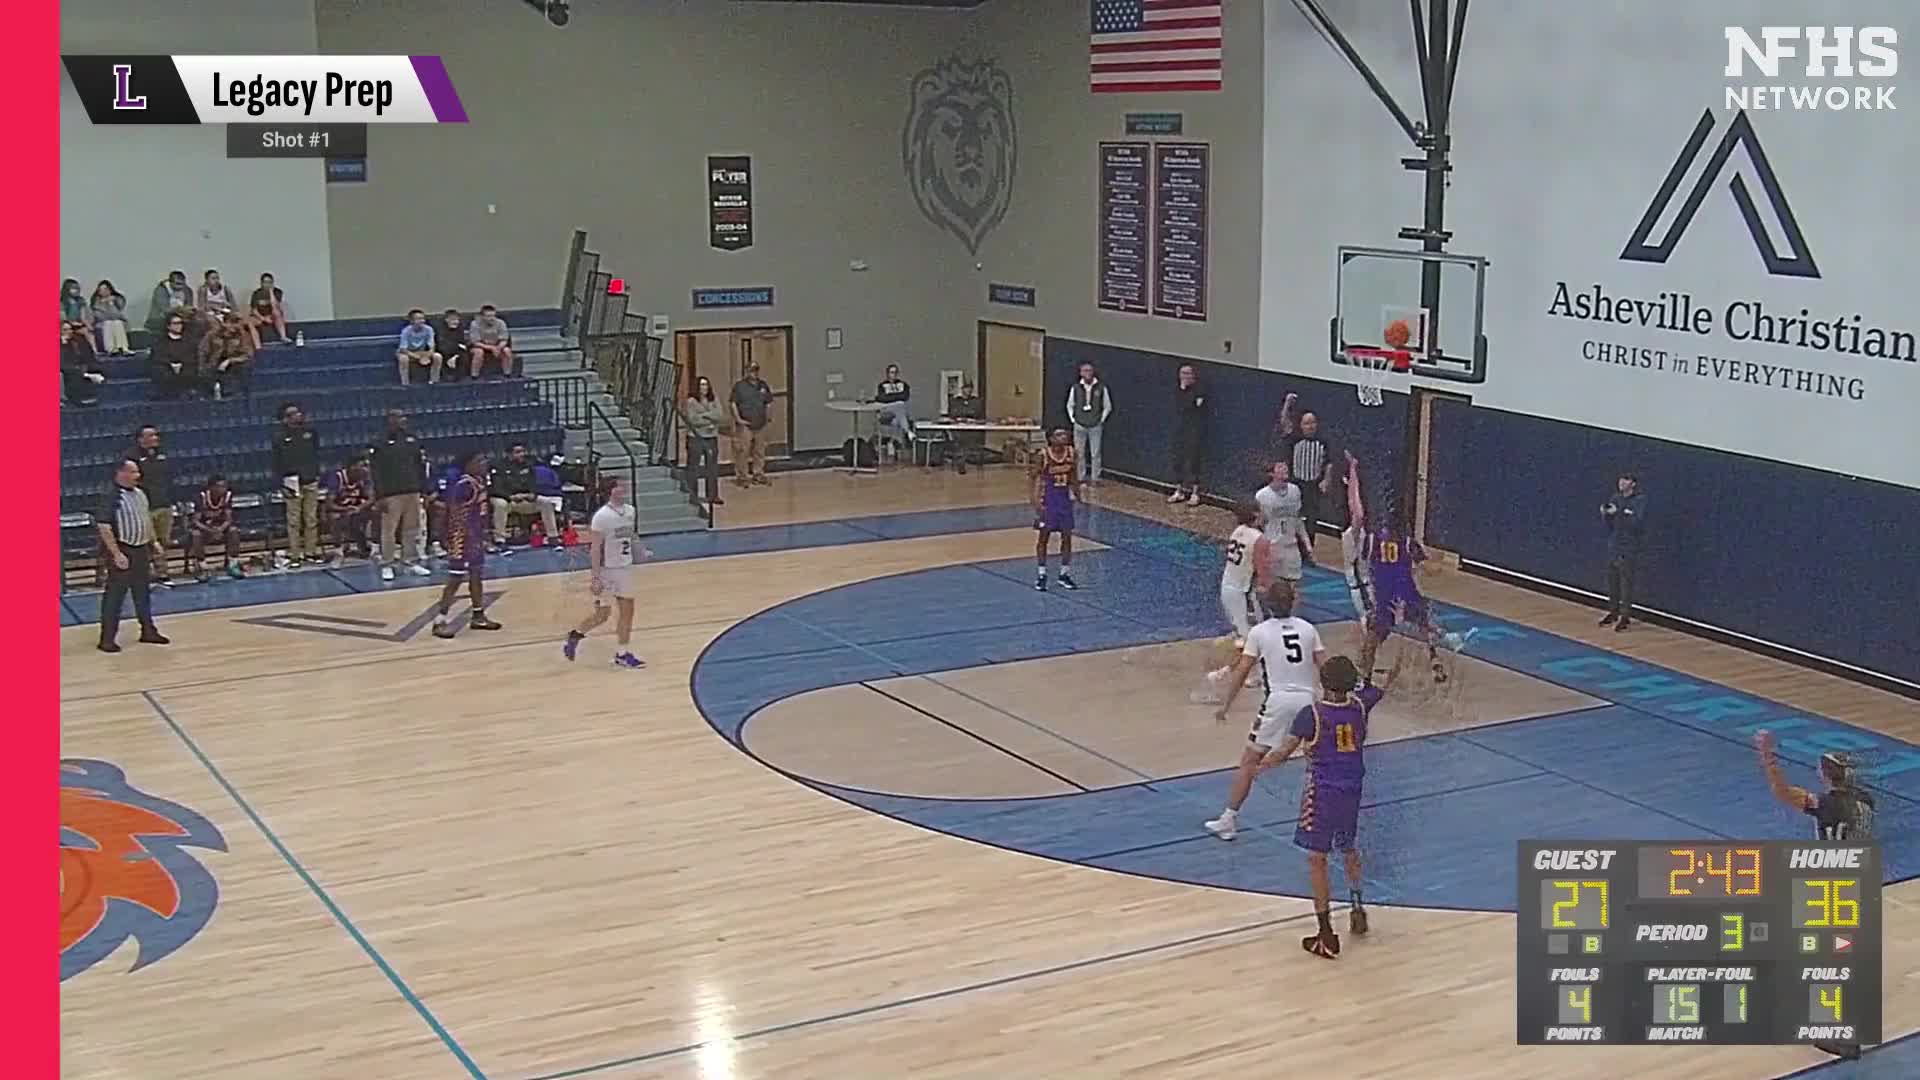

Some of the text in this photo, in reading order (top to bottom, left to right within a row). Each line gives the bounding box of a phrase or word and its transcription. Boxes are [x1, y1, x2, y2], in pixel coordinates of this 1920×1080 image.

[1548, 282, 1918, 362] Asheville Christian
[1582, 340, 1865, 401] CHRIST in EVERYTHING
[1227, 539, 1246, 566] 25
[1380, 541, 1399, 563] 10
[1282, 633, 1303, 664] 5
